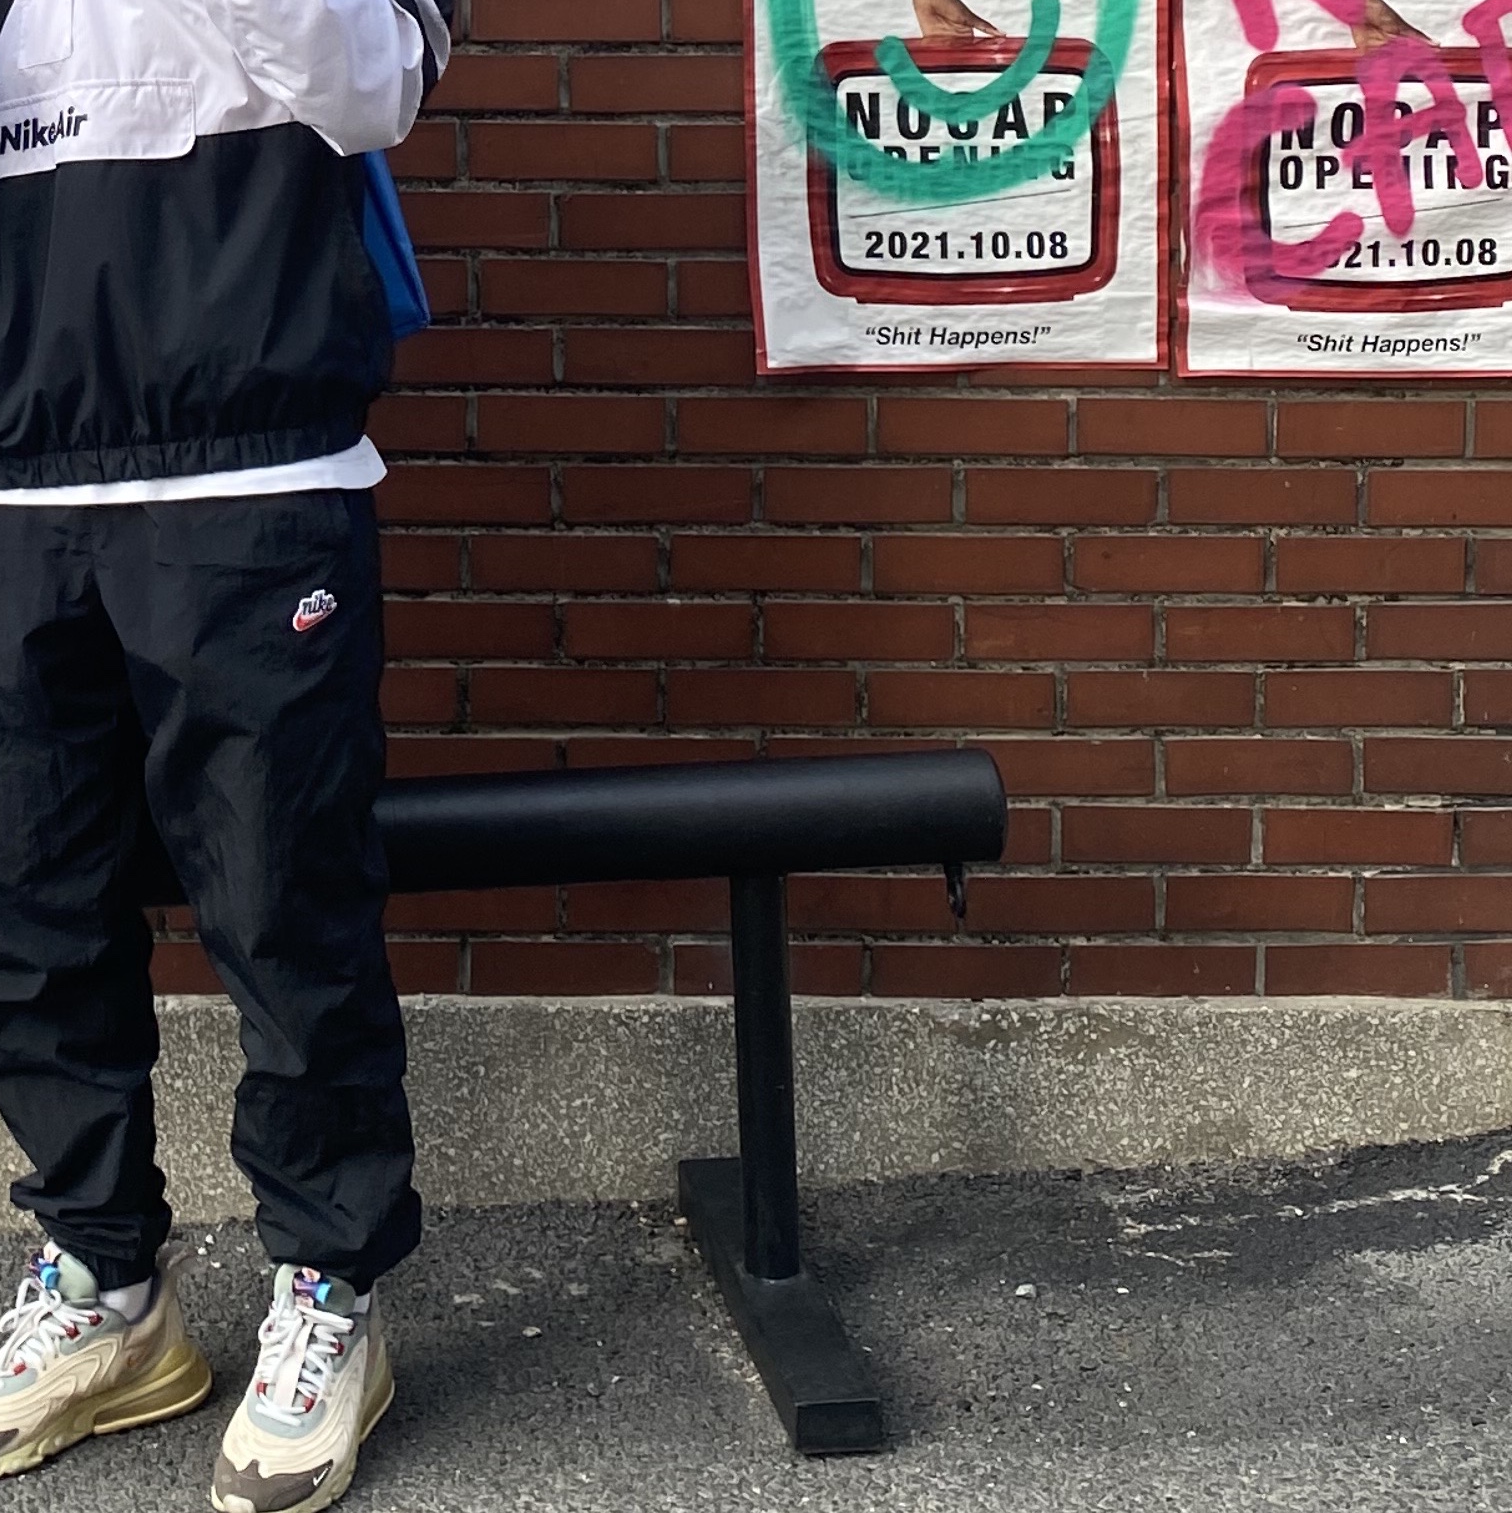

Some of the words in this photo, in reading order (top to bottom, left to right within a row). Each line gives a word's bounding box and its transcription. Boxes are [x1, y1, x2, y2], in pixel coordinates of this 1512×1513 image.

[865, 231, 1069, 260] 2021.10.08
[865, 326, 924, 346] “Shit
[929, 325, 1052, 349] Happens!”
[1296, 334, 1355, 354] “Shit
[1361, 332, 1482, 356] Happens!”
